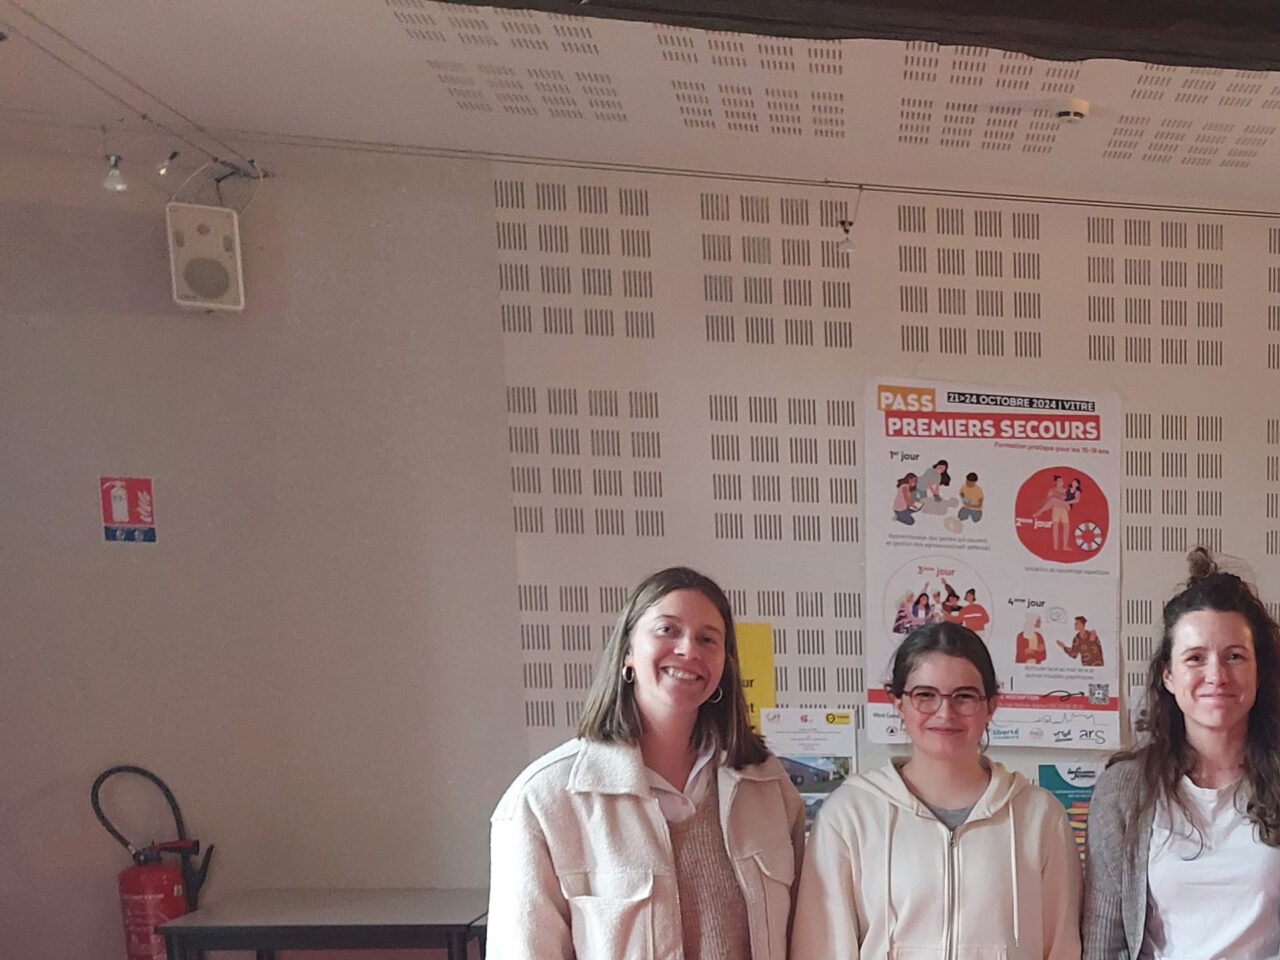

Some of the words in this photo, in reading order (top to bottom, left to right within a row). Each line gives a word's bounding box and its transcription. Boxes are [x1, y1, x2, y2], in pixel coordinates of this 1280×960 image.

[880, 391, 934, 412] PASS
[979, 395, 1030, 407] OCTOBRE
[1032, 399, 1057, 409] 2024
[887, 417, 996, 437] PREMIERS
[1000, 419, 1098, 439] SECOURS
[900, 450, 920, 462] jour
[1033, 517, 1053, 530] jour
[936, 566, 956, 577] jour
[1026, 598, 1046, 609] jour
